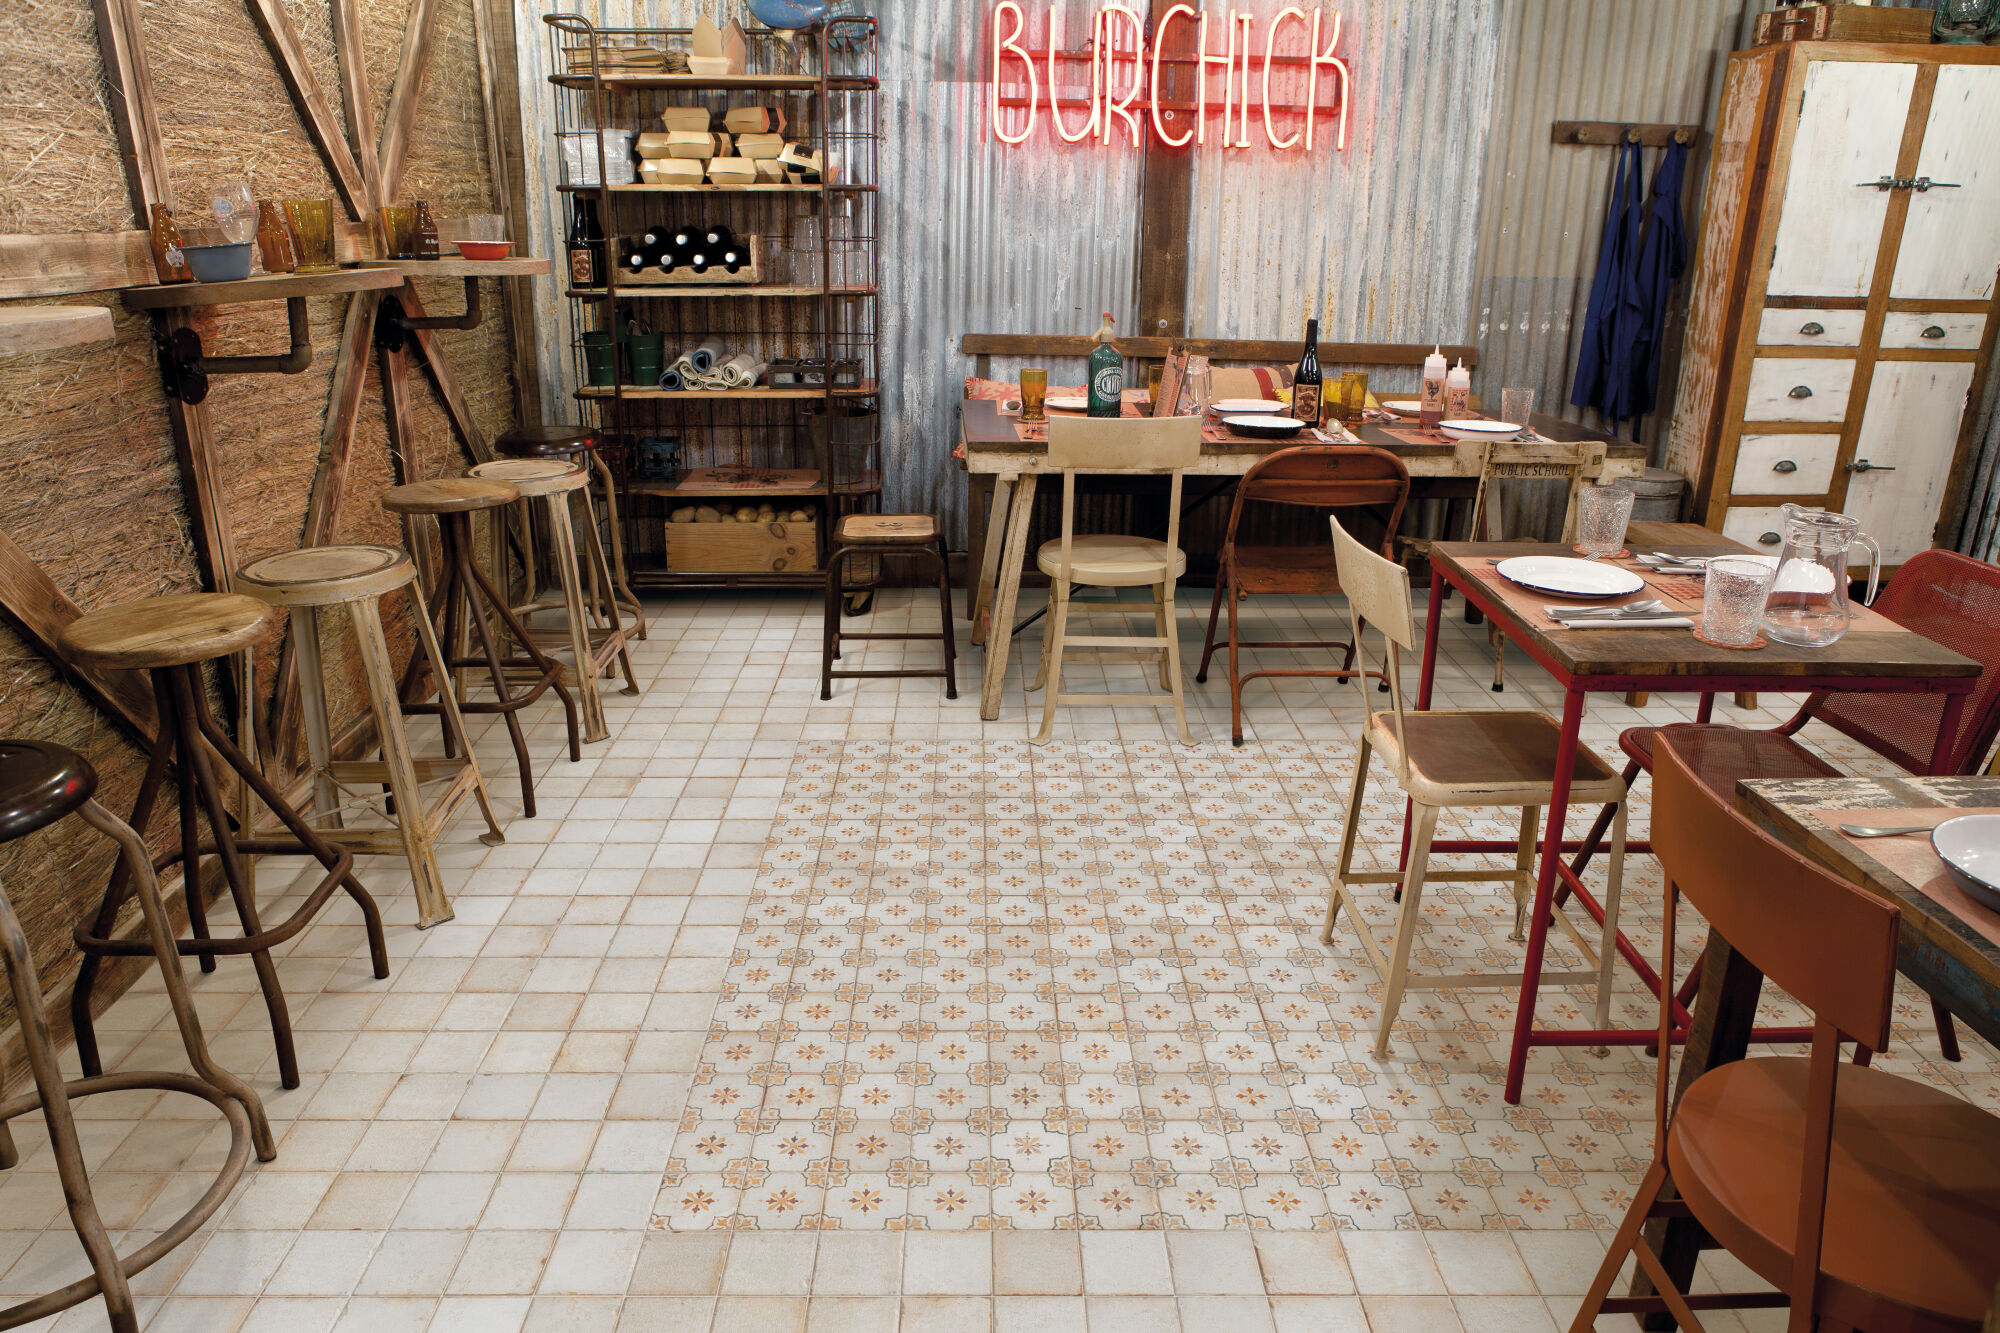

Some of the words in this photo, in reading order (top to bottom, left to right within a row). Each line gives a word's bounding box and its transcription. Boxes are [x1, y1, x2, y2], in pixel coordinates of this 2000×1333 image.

[993, 1, 1349, 151] BURCHICK
[1494, 463, 1530, 476] PUBLIC
[1532, 463, 1570, 476] SCHOOL
